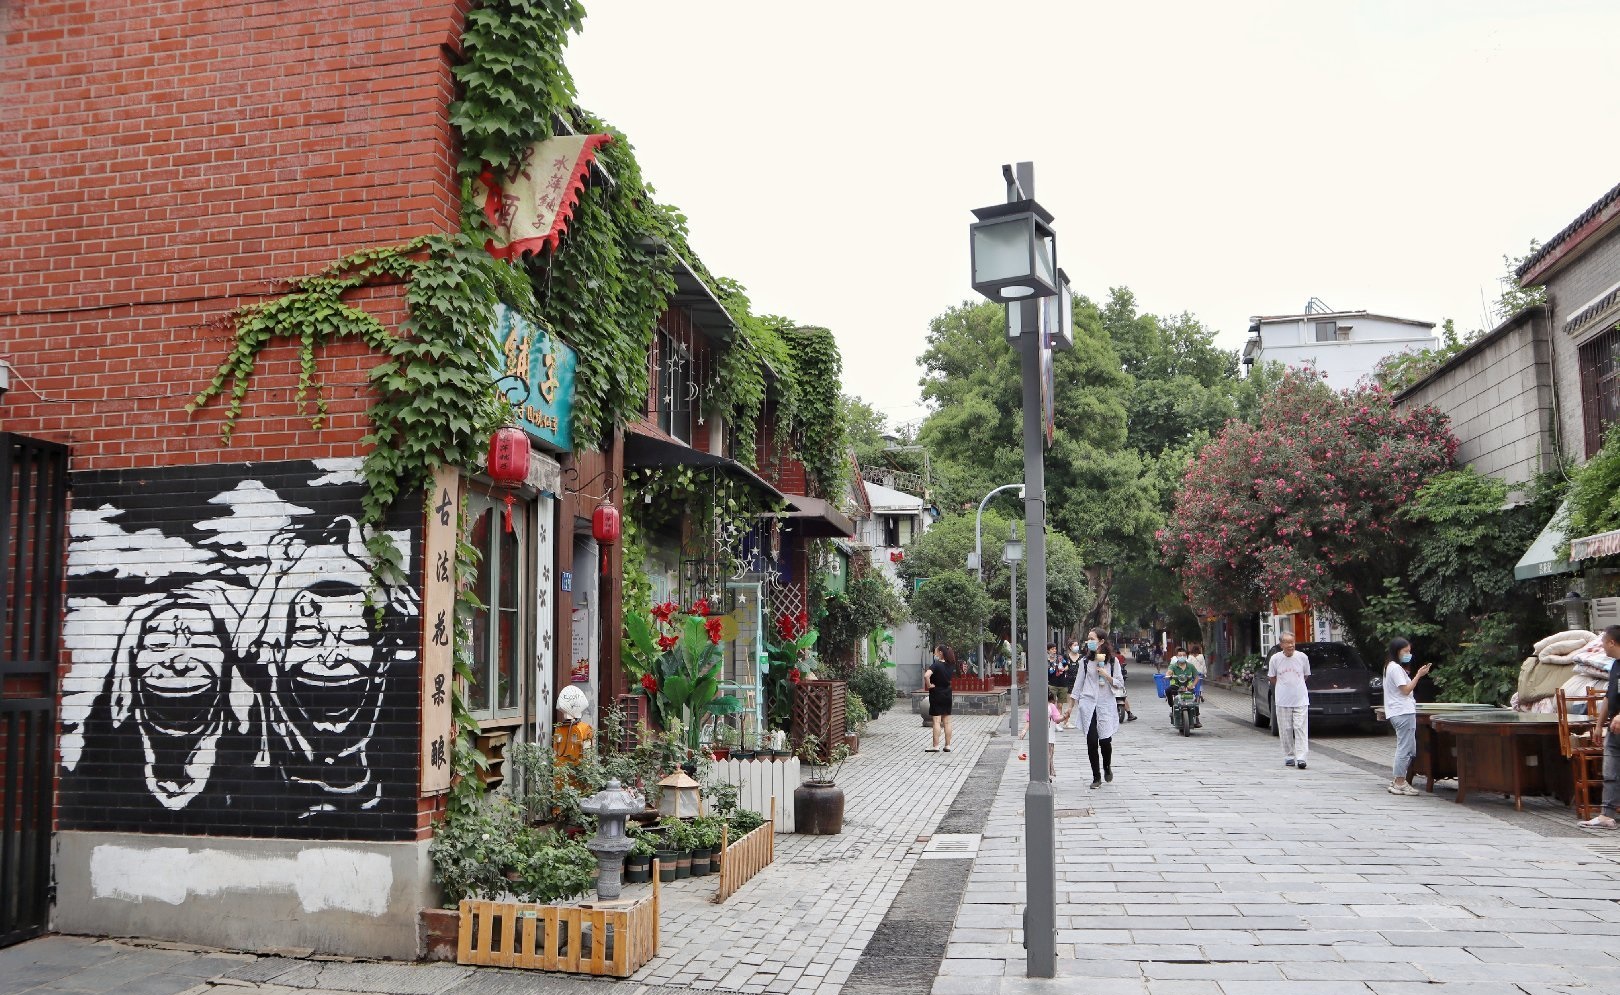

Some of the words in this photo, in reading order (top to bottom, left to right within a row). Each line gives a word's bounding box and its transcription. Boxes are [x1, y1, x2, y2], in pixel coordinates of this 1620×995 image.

[430, 488, 452, 770] 古法花果酿
